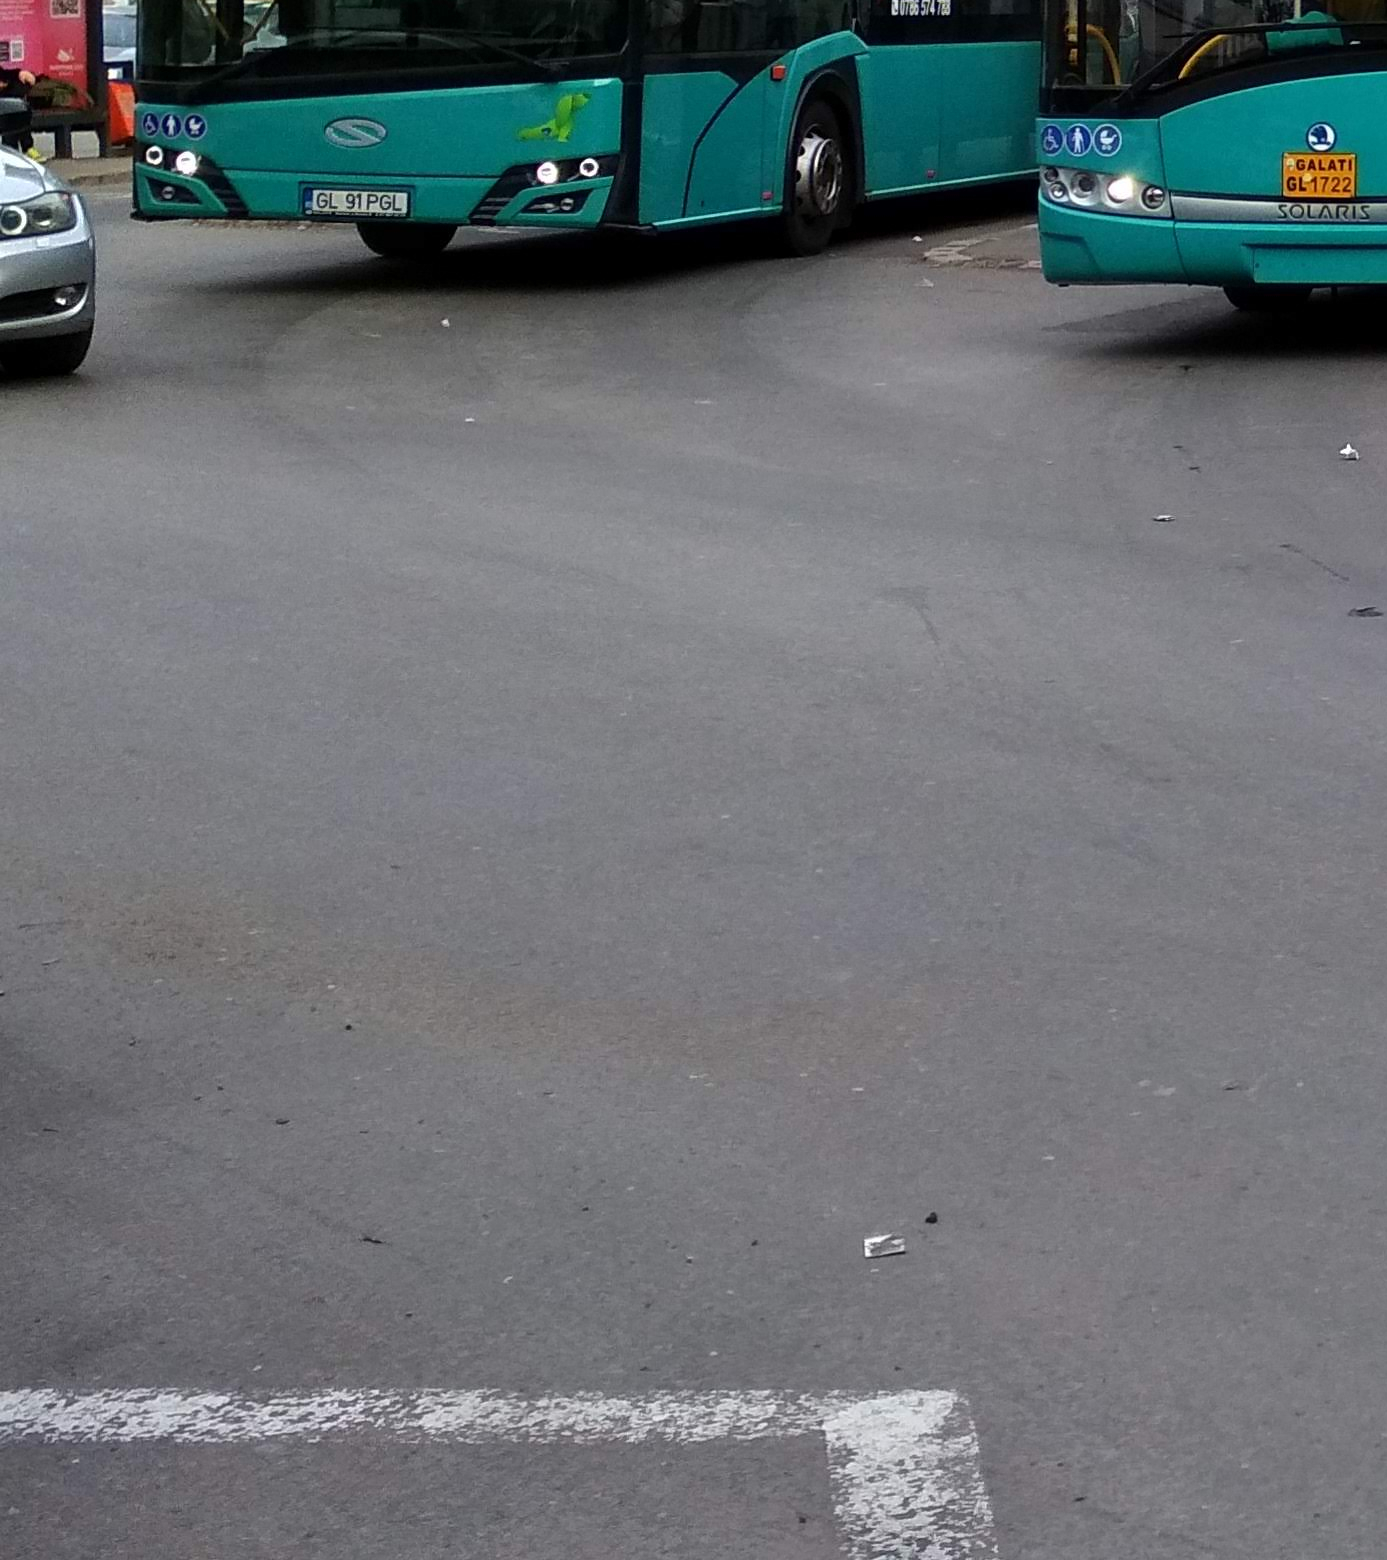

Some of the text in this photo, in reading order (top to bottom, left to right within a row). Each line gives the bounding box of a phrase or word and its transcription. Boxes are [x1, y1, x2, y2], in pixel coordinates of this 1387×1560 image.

[1296, 159, 1352, 171] GALATI
[1311, 177, 1352, 193] 1722
[316, 192, 339, 210] GL
[1277, 204, 1370, 220] SOLARIS
